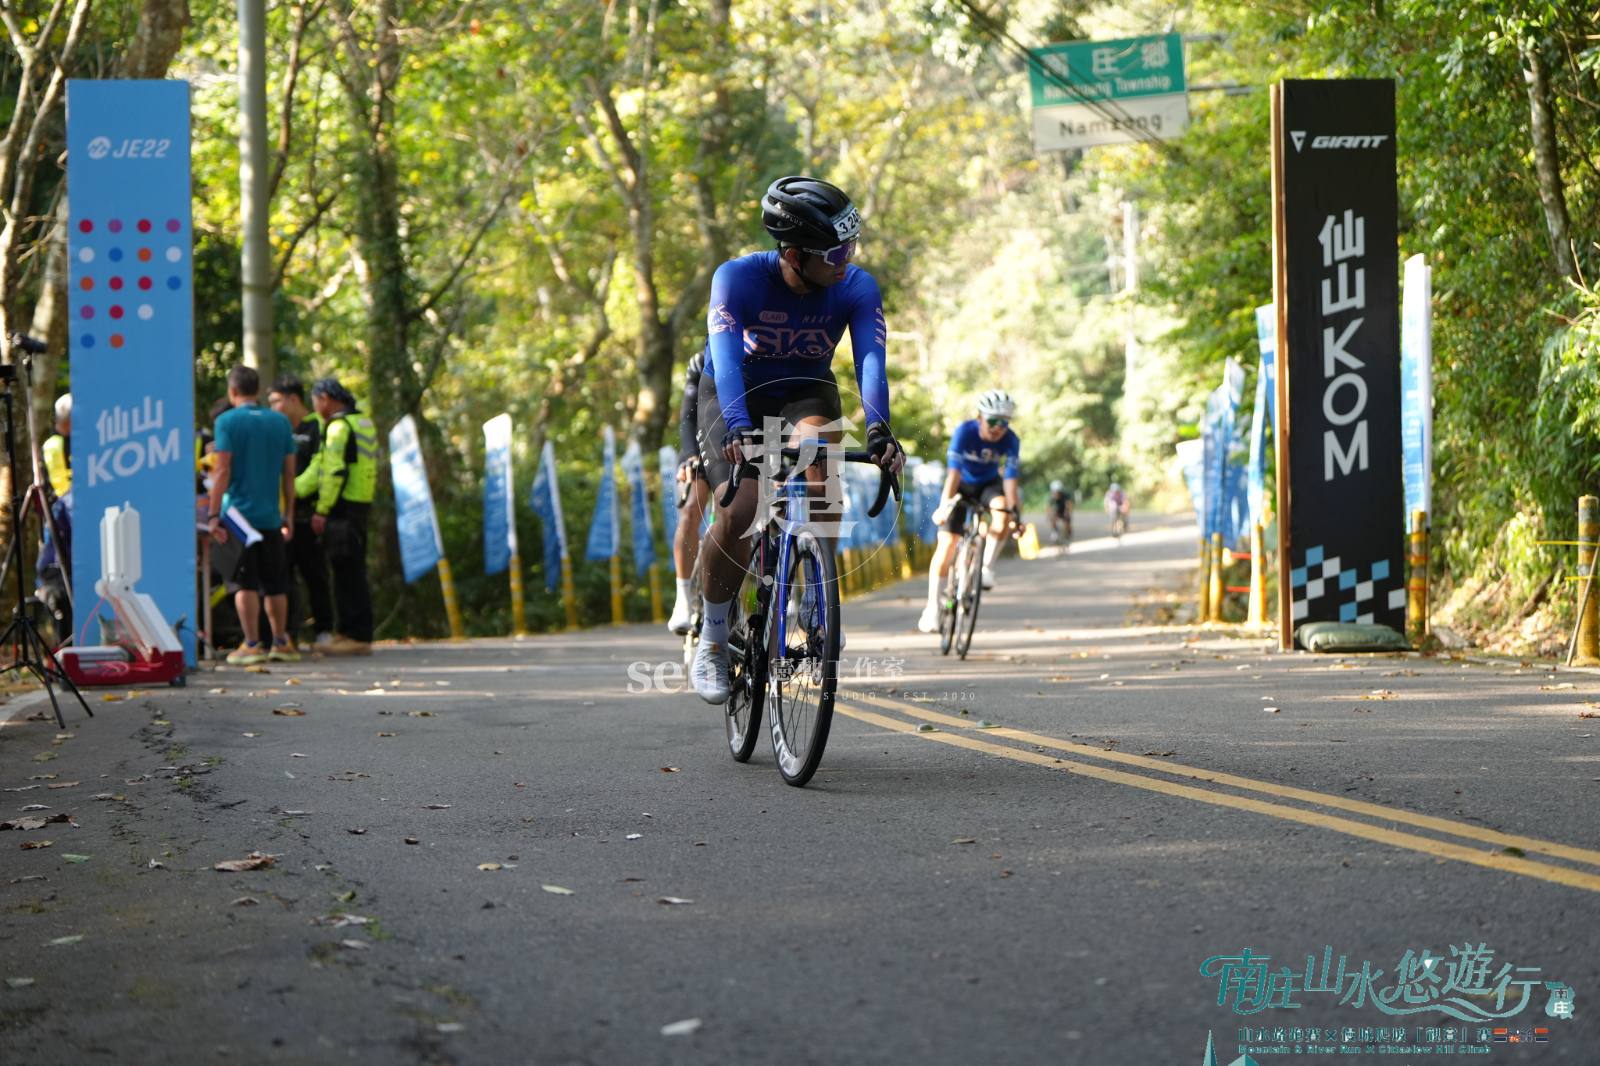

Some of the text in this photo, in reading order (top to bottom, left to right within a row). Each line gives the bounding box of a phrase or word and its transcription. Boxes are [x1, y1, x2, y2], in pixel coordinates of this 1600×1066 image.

[112, 139, 171, 158] JE22
[1311, 135, 1389, 149] GIANT
[88, 427, 179, 488] KOM
